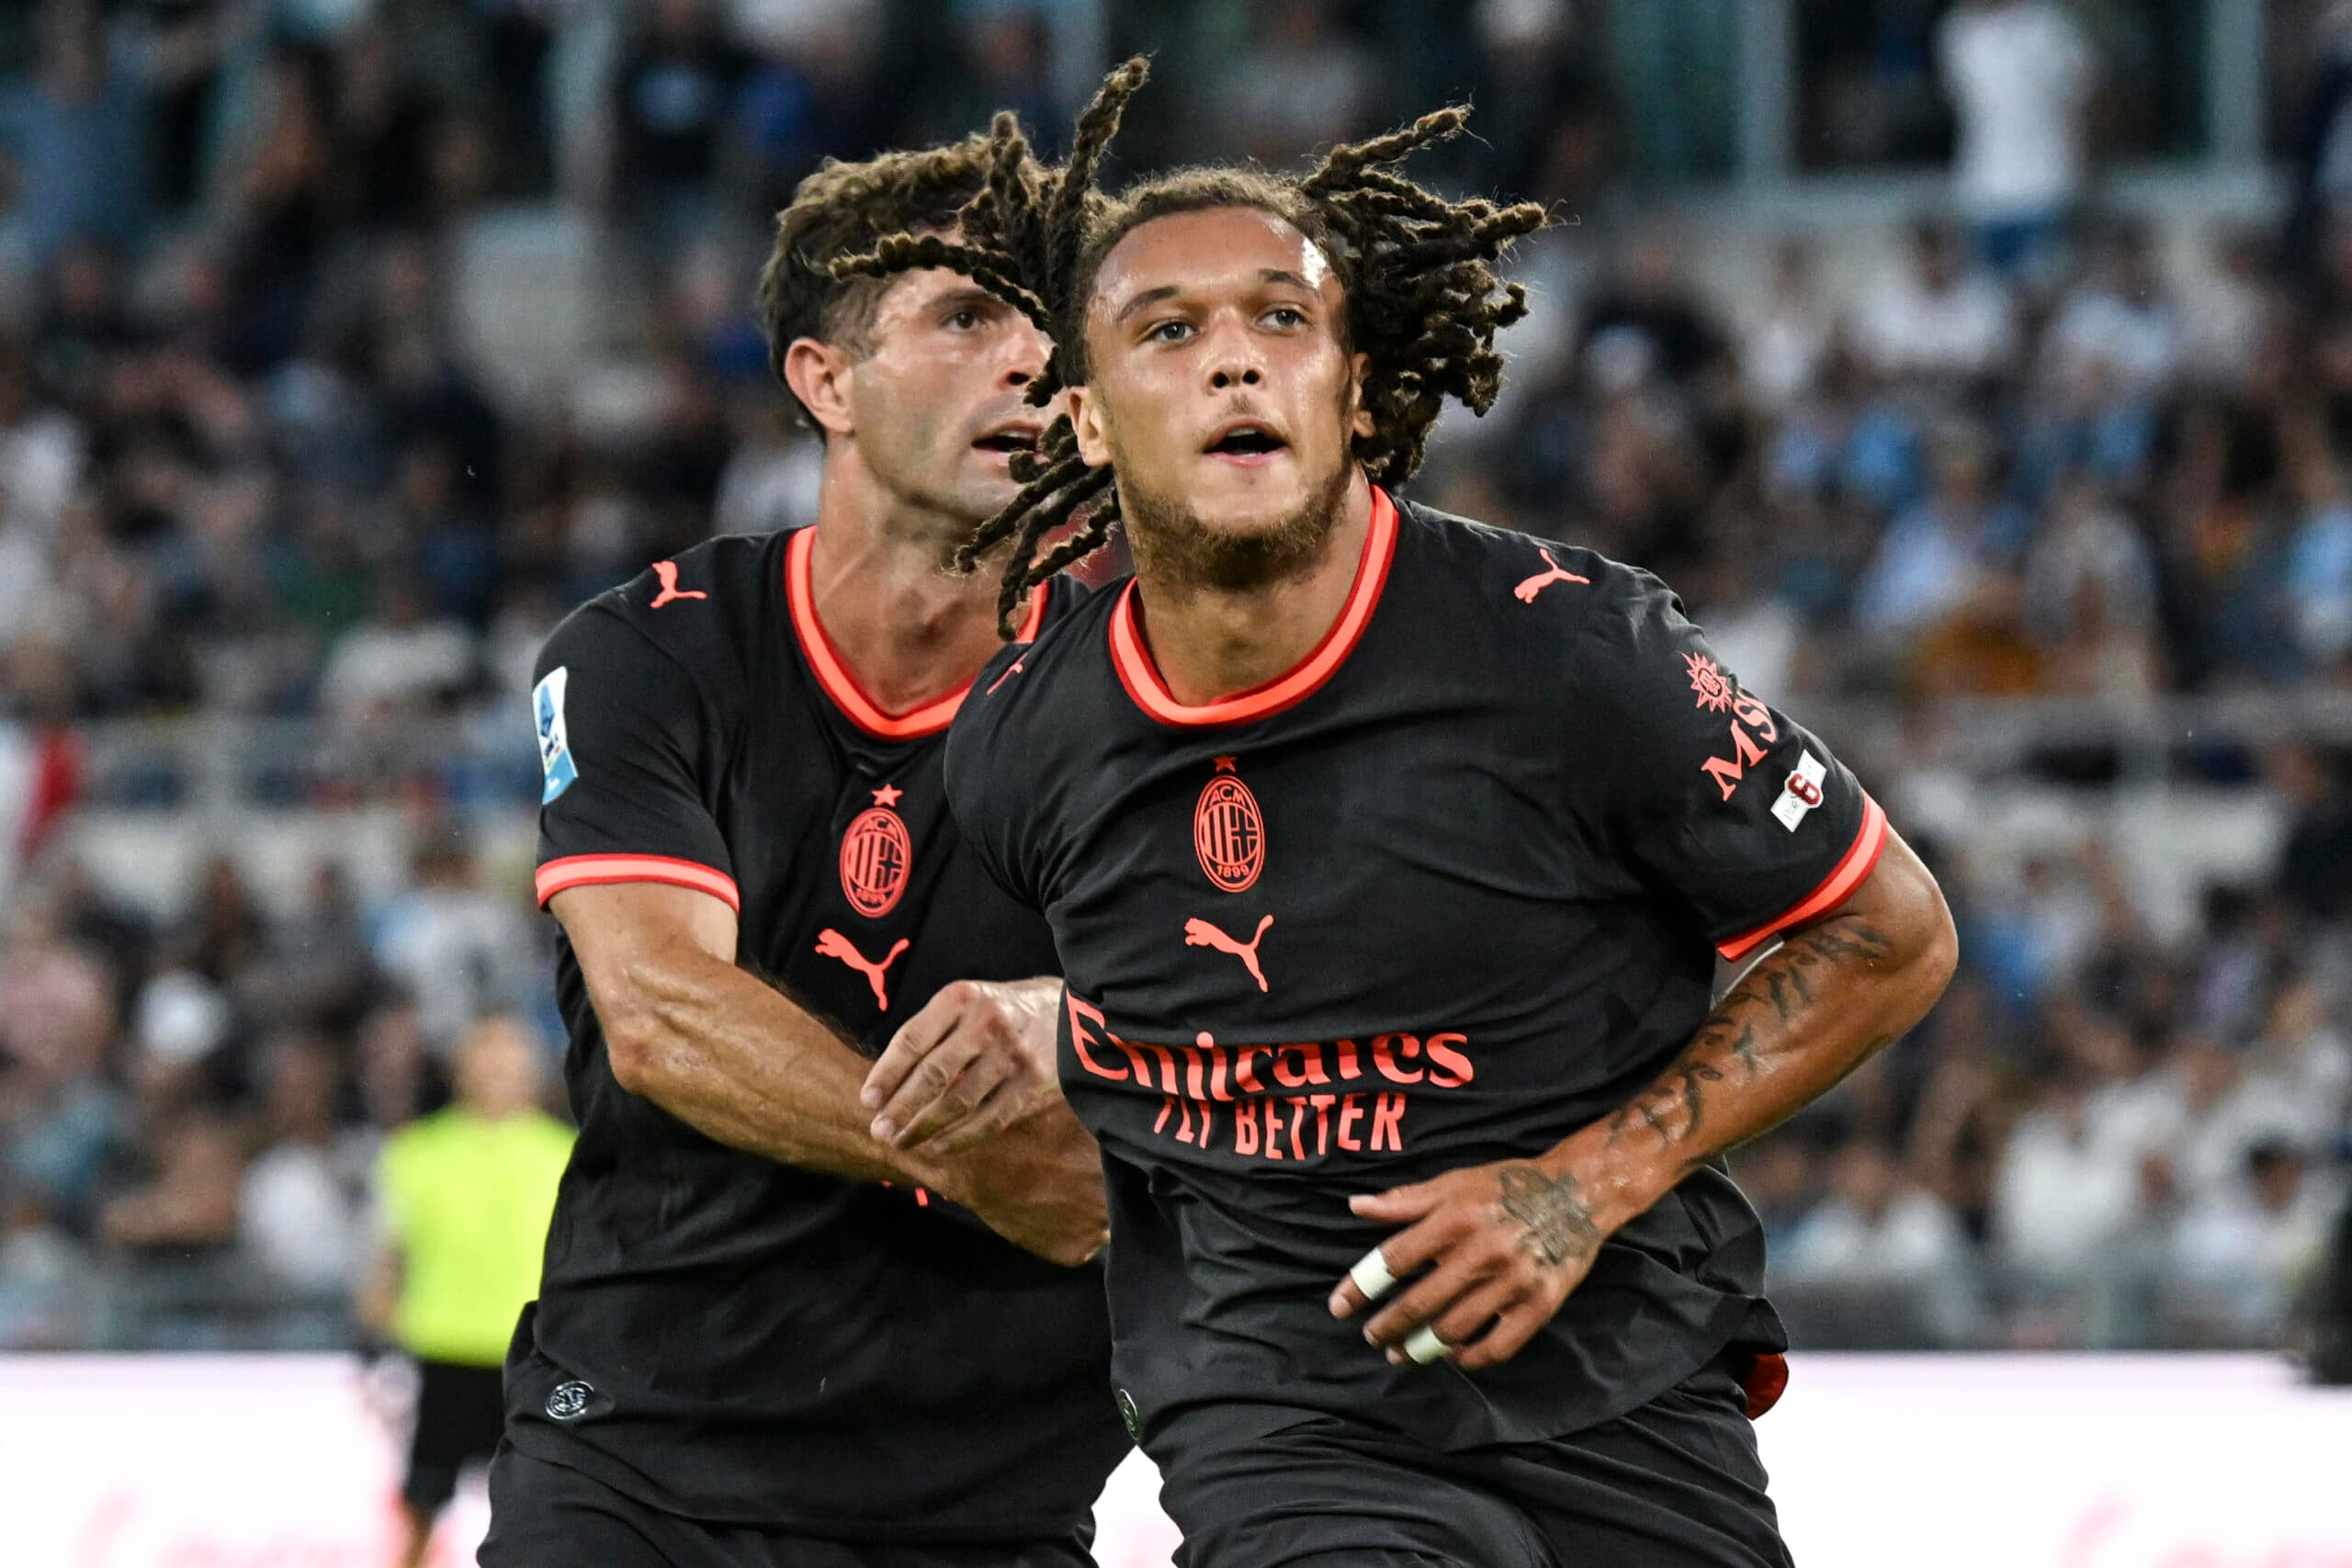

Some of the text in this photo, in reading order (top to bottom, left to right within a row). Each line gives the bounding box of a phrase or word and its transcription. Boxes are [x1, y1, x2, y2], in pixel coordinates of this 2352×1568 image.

[1209, 785, 1245, 807] ACM
[1788, 773, 1820, 805] 6
[1217, 865, 1250, 878] 1899
[1235, 1092, 1407, 1160] BETTER
